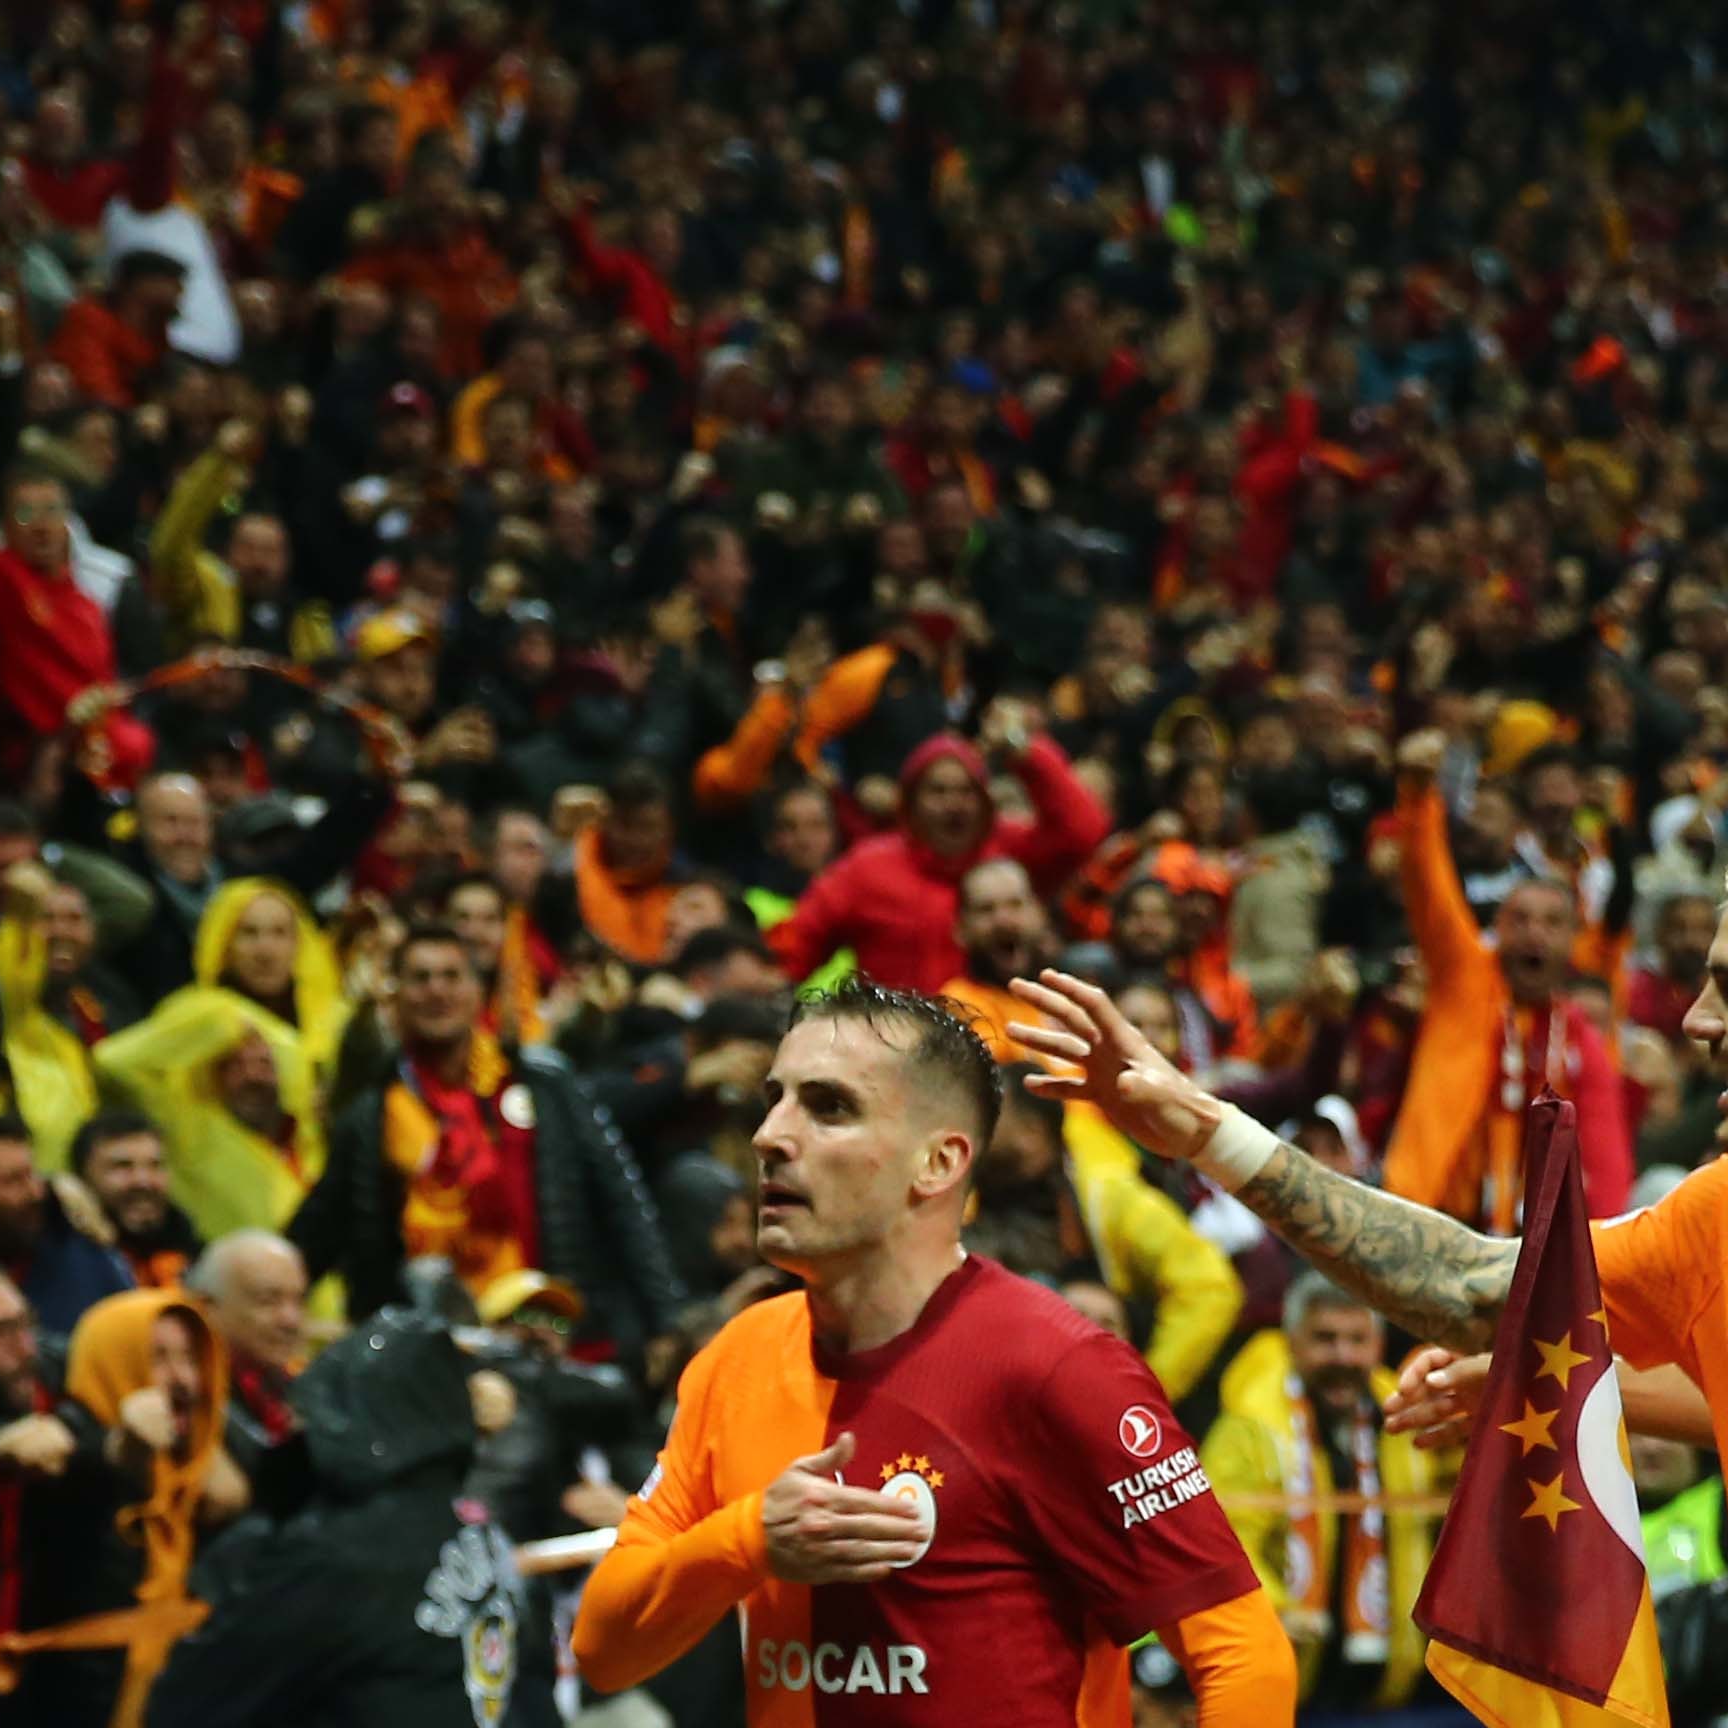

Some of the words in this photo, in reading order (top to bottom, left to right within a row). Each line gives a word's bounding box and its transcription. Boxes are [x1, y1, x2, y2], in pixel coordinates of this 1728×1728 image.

[1107, 1446, 1200, 1504] TURKISH
[1123, 1468, 1211, 1529] AIRLINES
[758, 1637, 929, 1695] SOCAR
